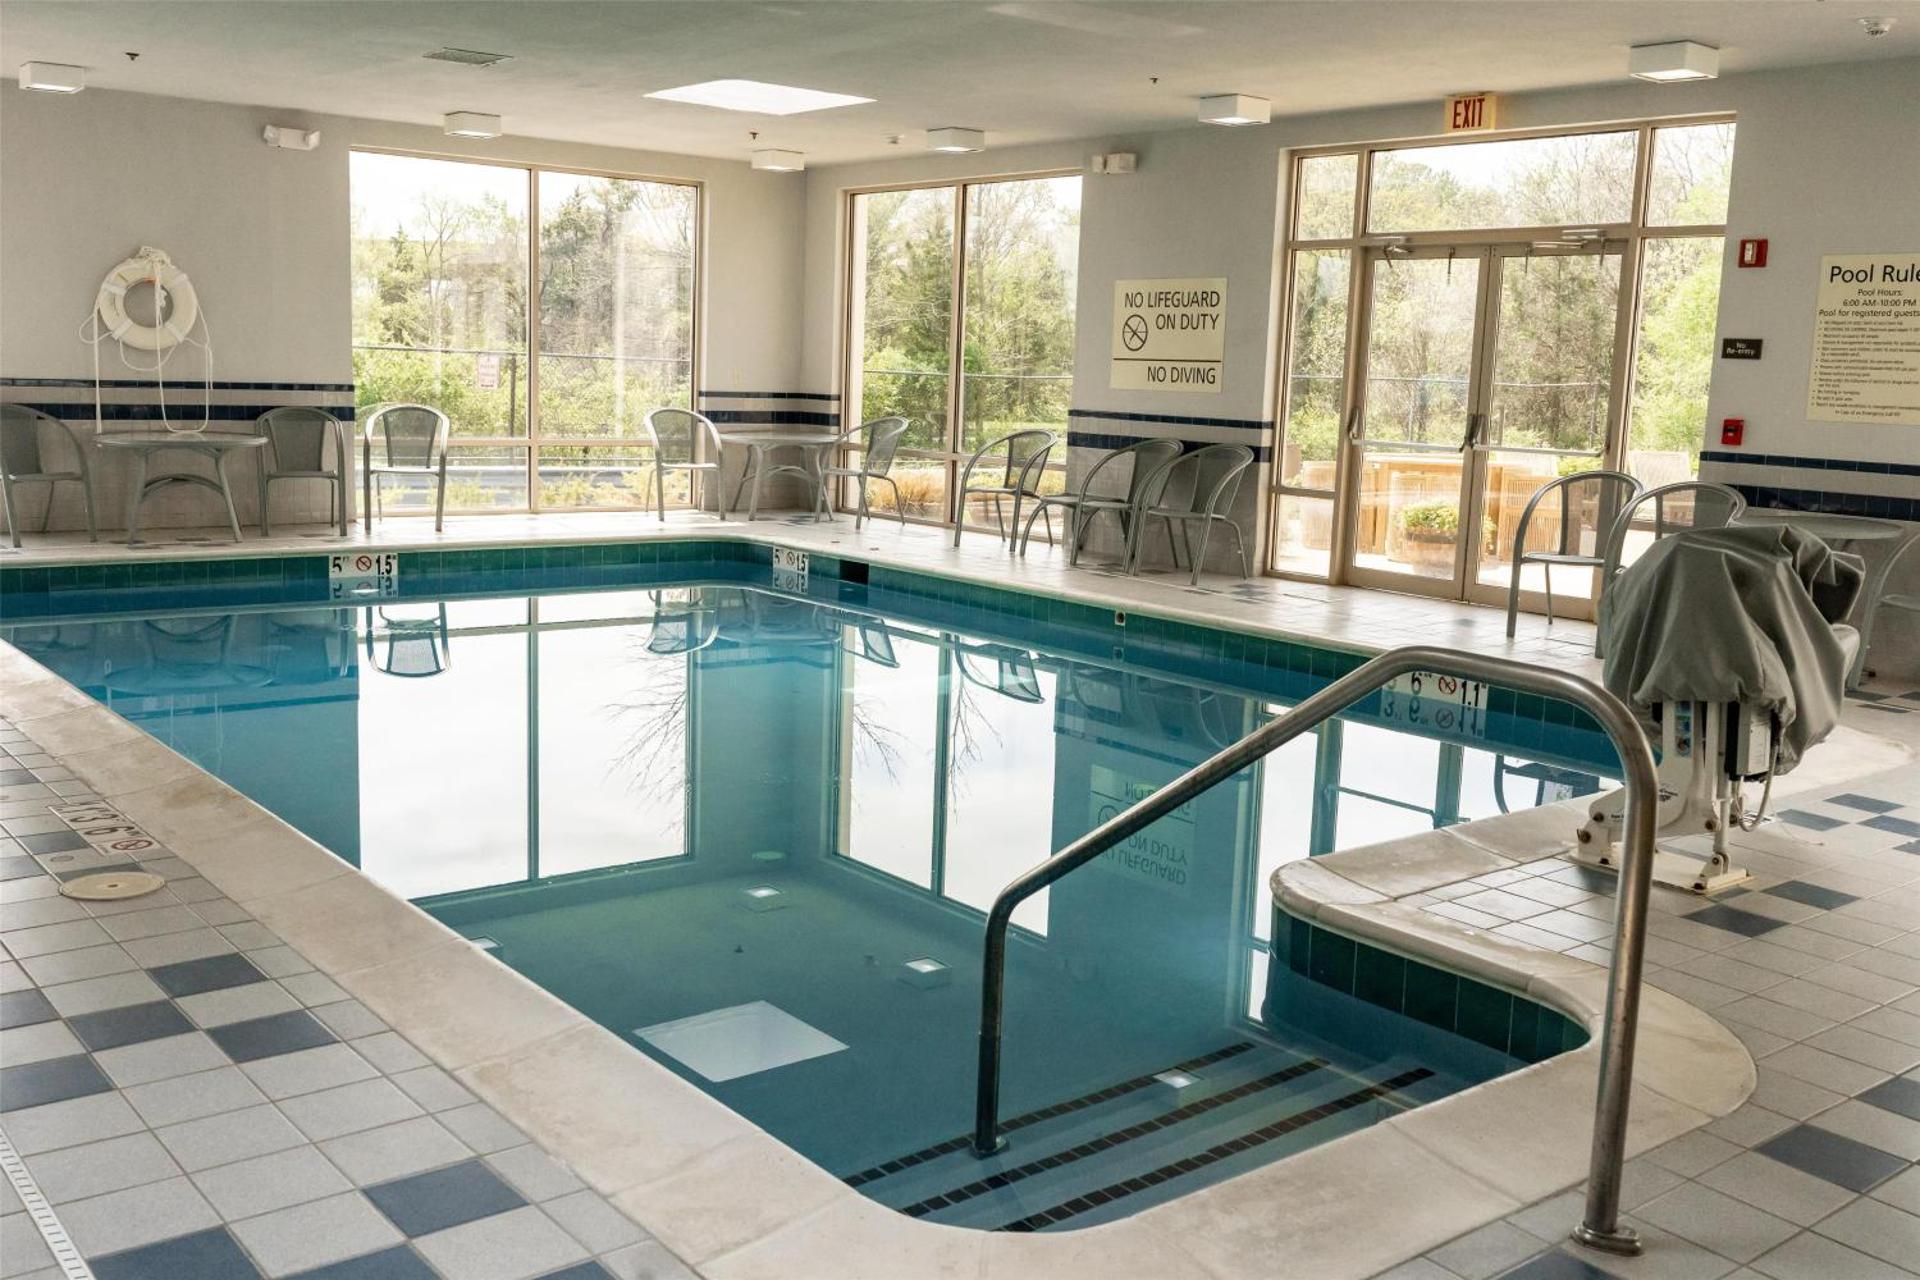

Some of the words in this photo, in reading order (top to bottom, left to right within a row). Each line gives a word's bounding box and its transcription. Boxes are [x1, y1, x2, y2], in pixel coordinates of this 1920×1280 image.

[1453, 98, 1485, 128] EXIT
[1830, 263, 1874, 283] Pool
[1125, 292, 1144, 308] NO
[1147, 291, 1221, 308] LIFEGUARD
[1155, 313, 1176, 330] ON
[1180, 313, 1220, 331] DUTY
[1851, 309, 1892, 318] registered
[1147, 366, 1167, 383] NO
[1170, 367, 1216, 385] DIVING
[332, 556, 342, 573] 5
[376, 554, 393, 576] 1.5
[1410, 671, 1422, 695] 6
[1461, 680, 1480, 708] 1.1
